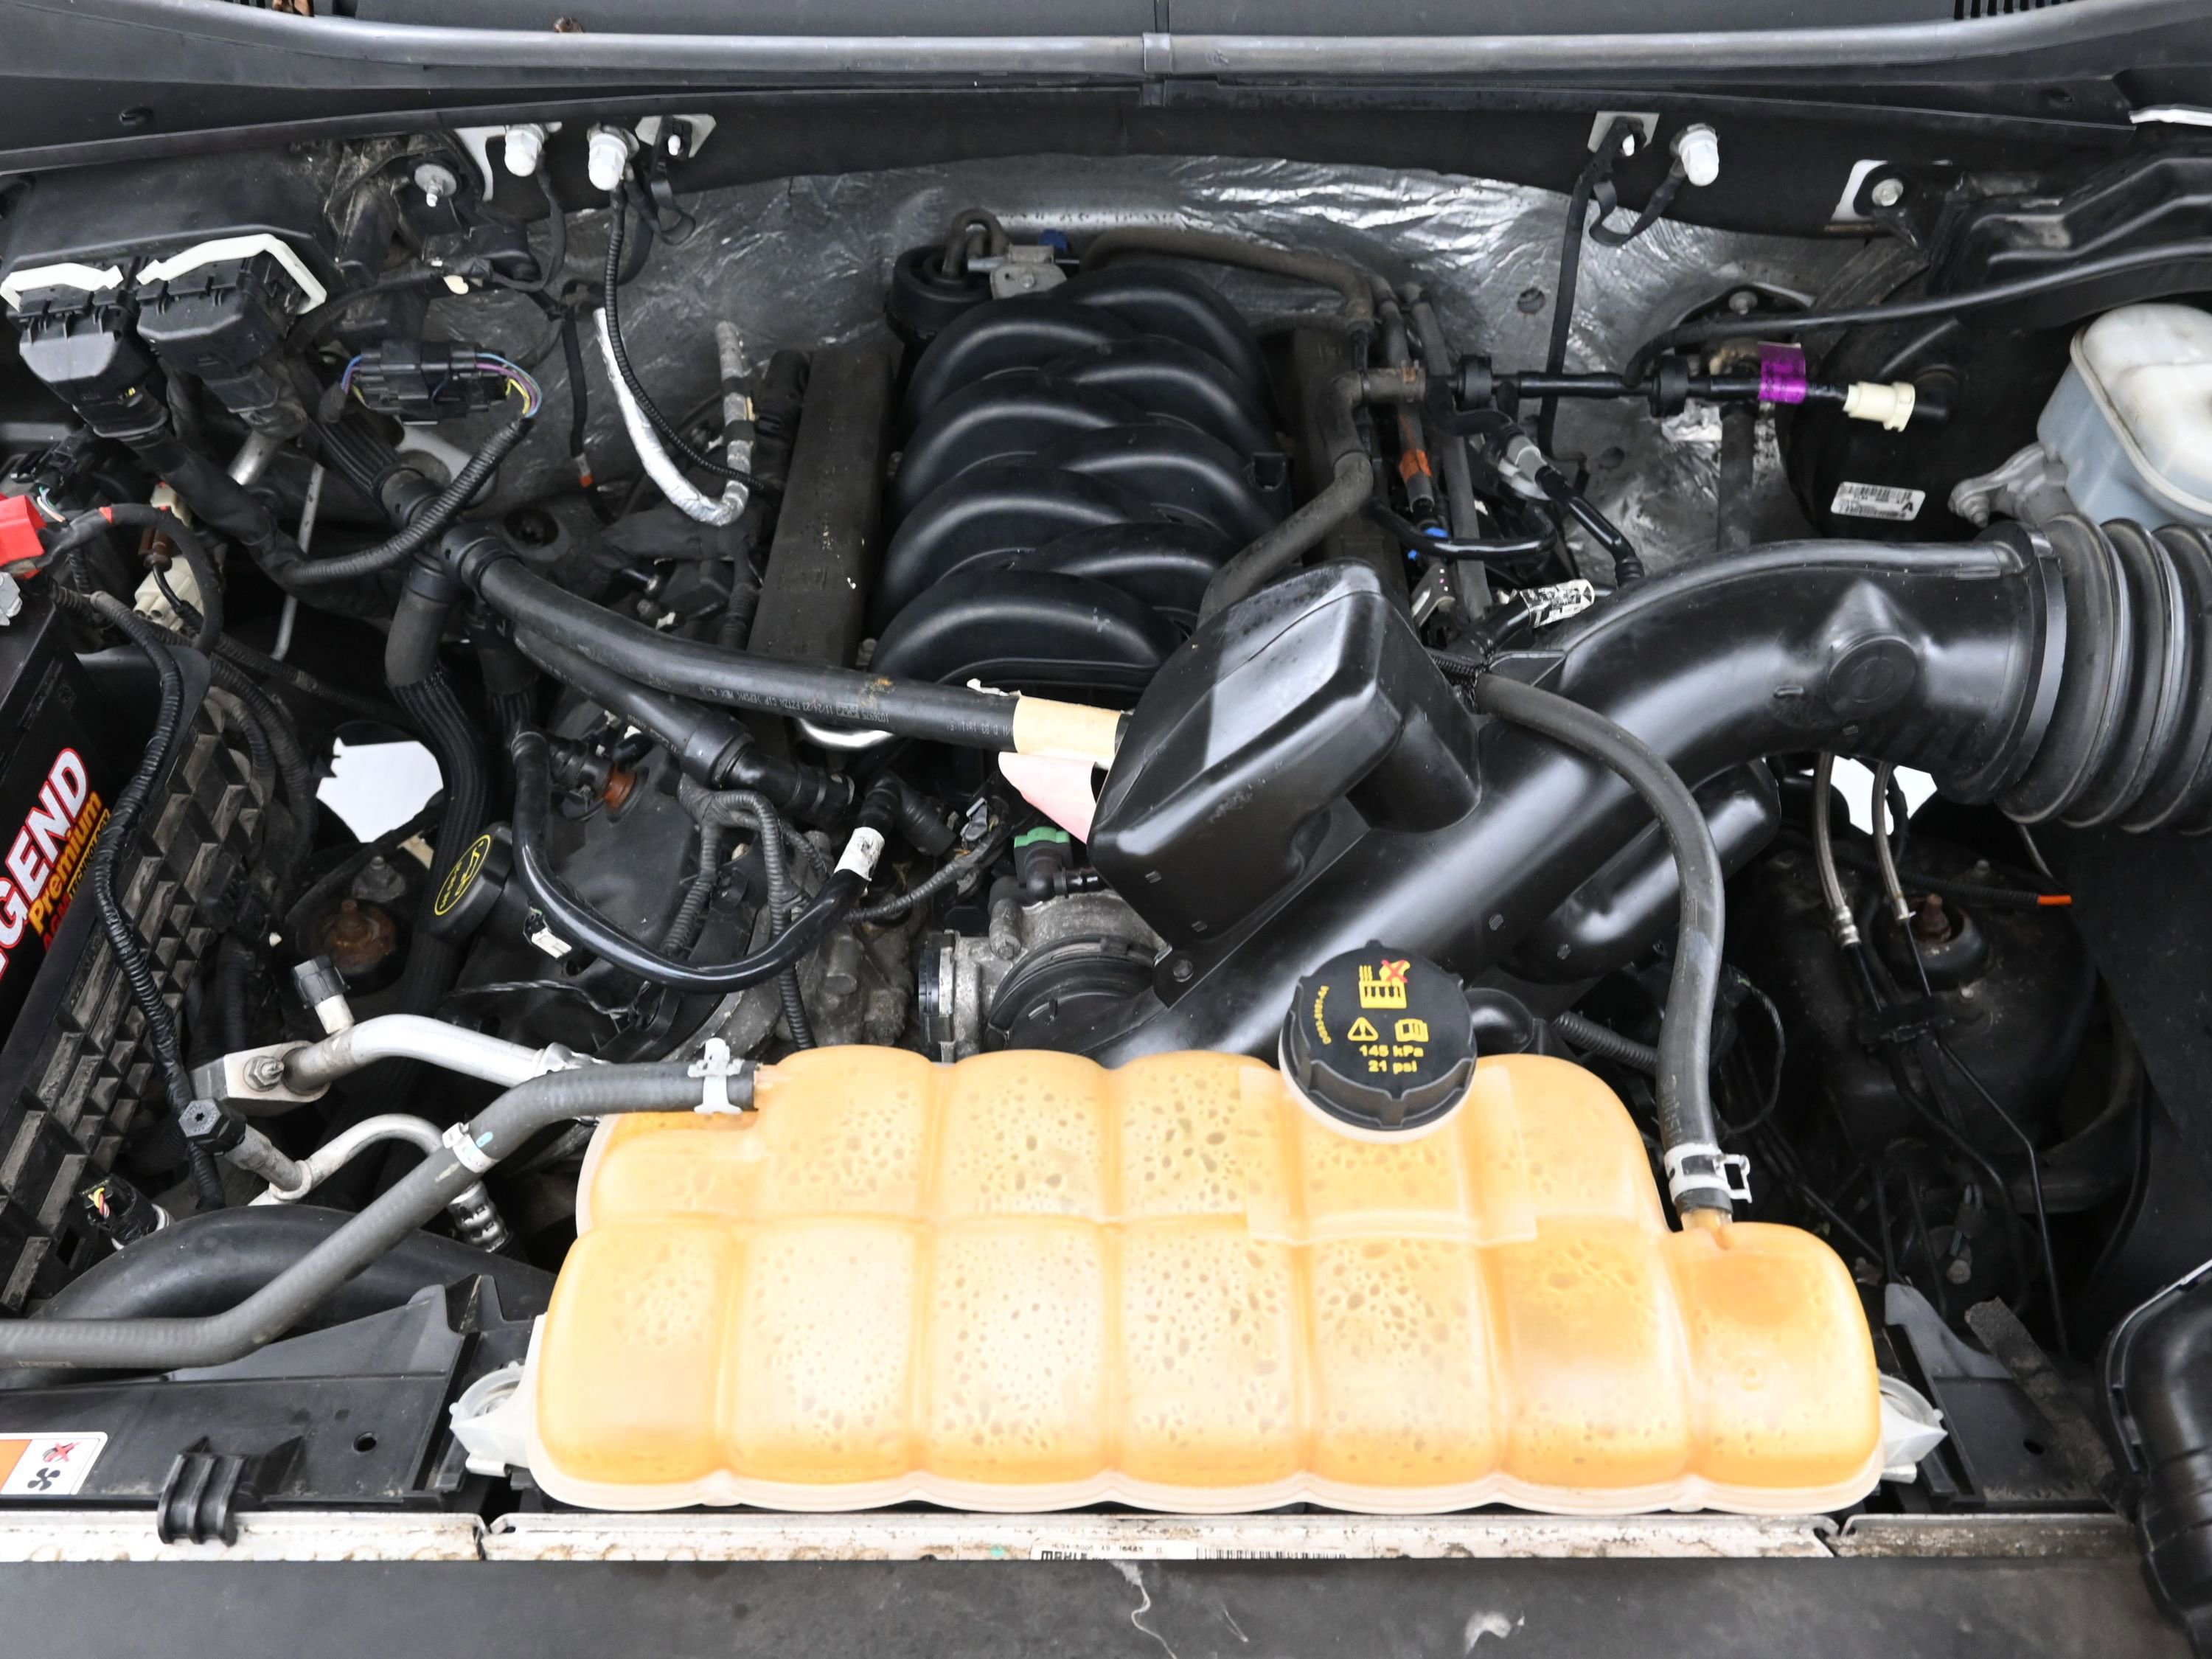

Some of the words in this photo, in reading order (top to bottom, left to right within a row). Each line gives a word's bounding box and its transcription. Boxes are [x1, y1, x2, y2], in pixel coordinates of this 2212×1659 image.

[28, 790, 102, 935] Premium
[1359, 1044, 1389, 1057] 145
[1393, 1044, 1424, 1057] kPa
[1368, 1060, 1388, 1072] 21
[1392, 1060, 1418, 1074] psi
